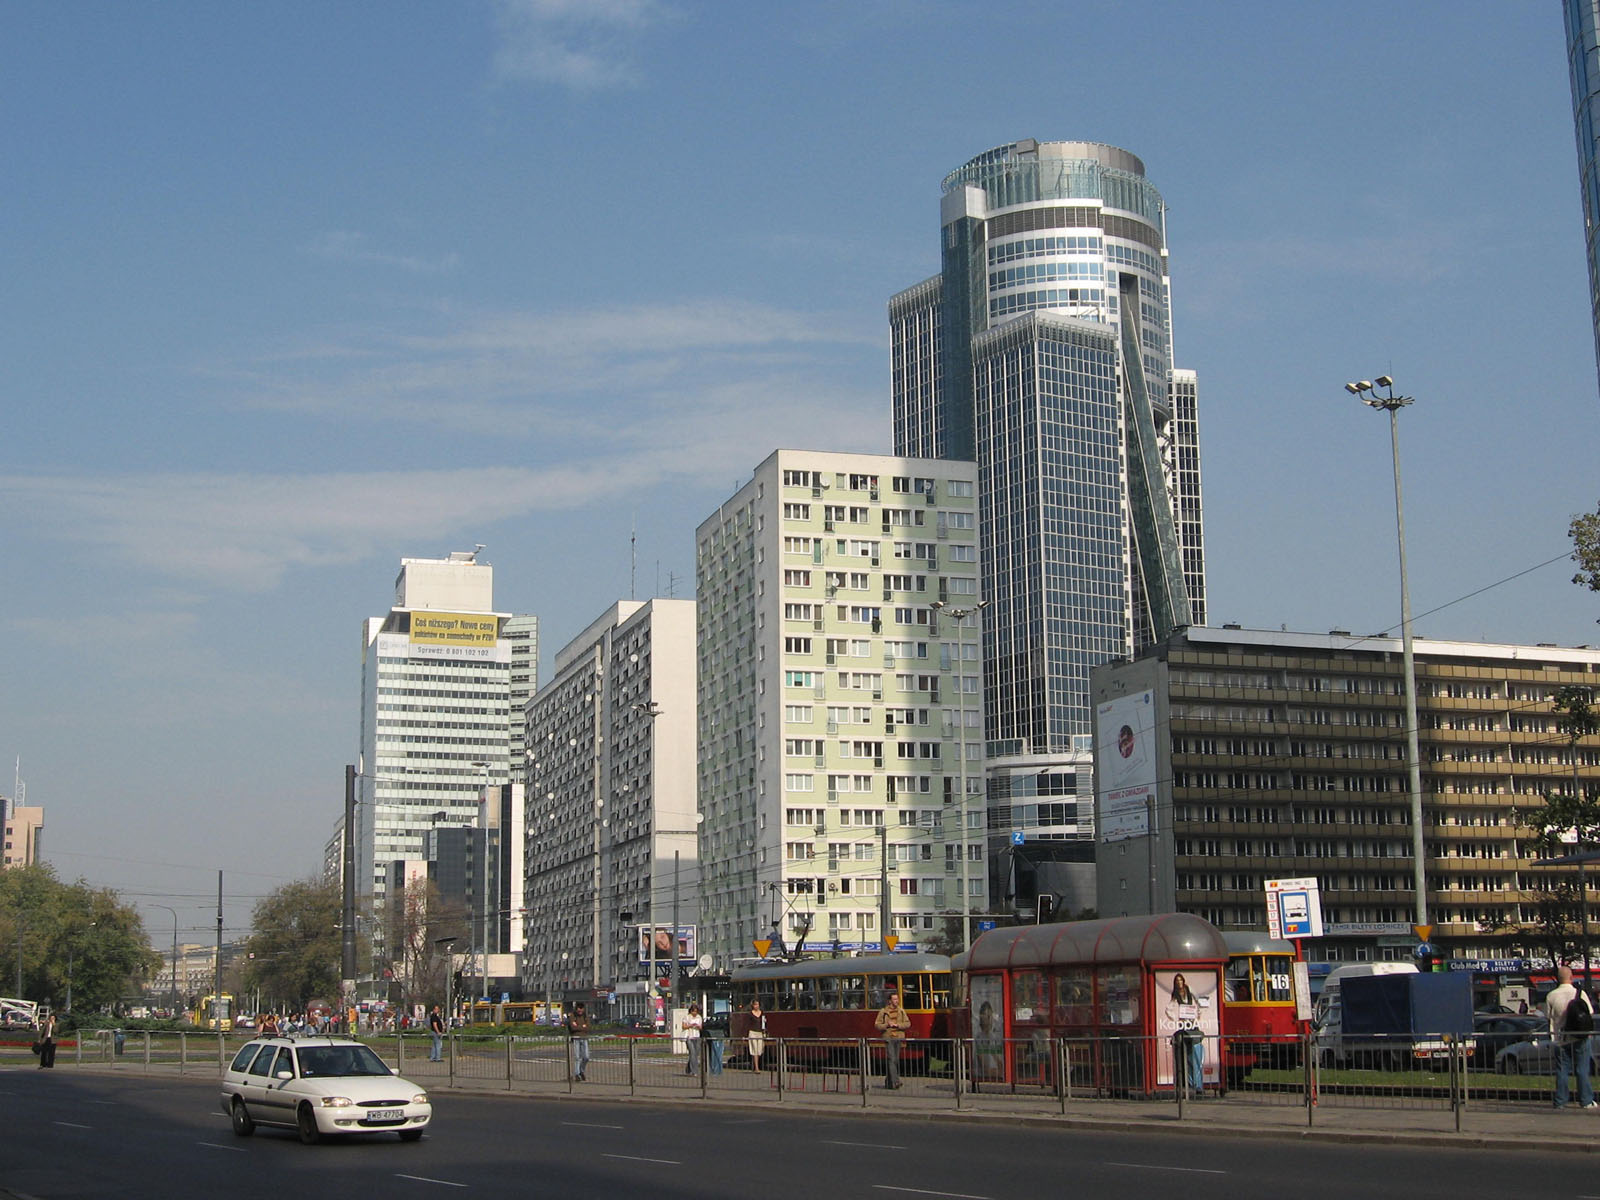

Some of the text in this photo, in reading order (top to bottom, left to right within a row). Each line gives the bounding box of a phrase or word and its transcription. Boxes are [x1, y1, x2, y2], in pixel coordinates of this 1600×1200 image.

[415, 617, 494, 632] Coś niższego? Nowe ceny
[1015, 833, 1021, 841] Z
[1450, 961, 1465, 970] Club
[1466, 961, 1480, 970] Med
[1274, 975, 1287, 989] 16
